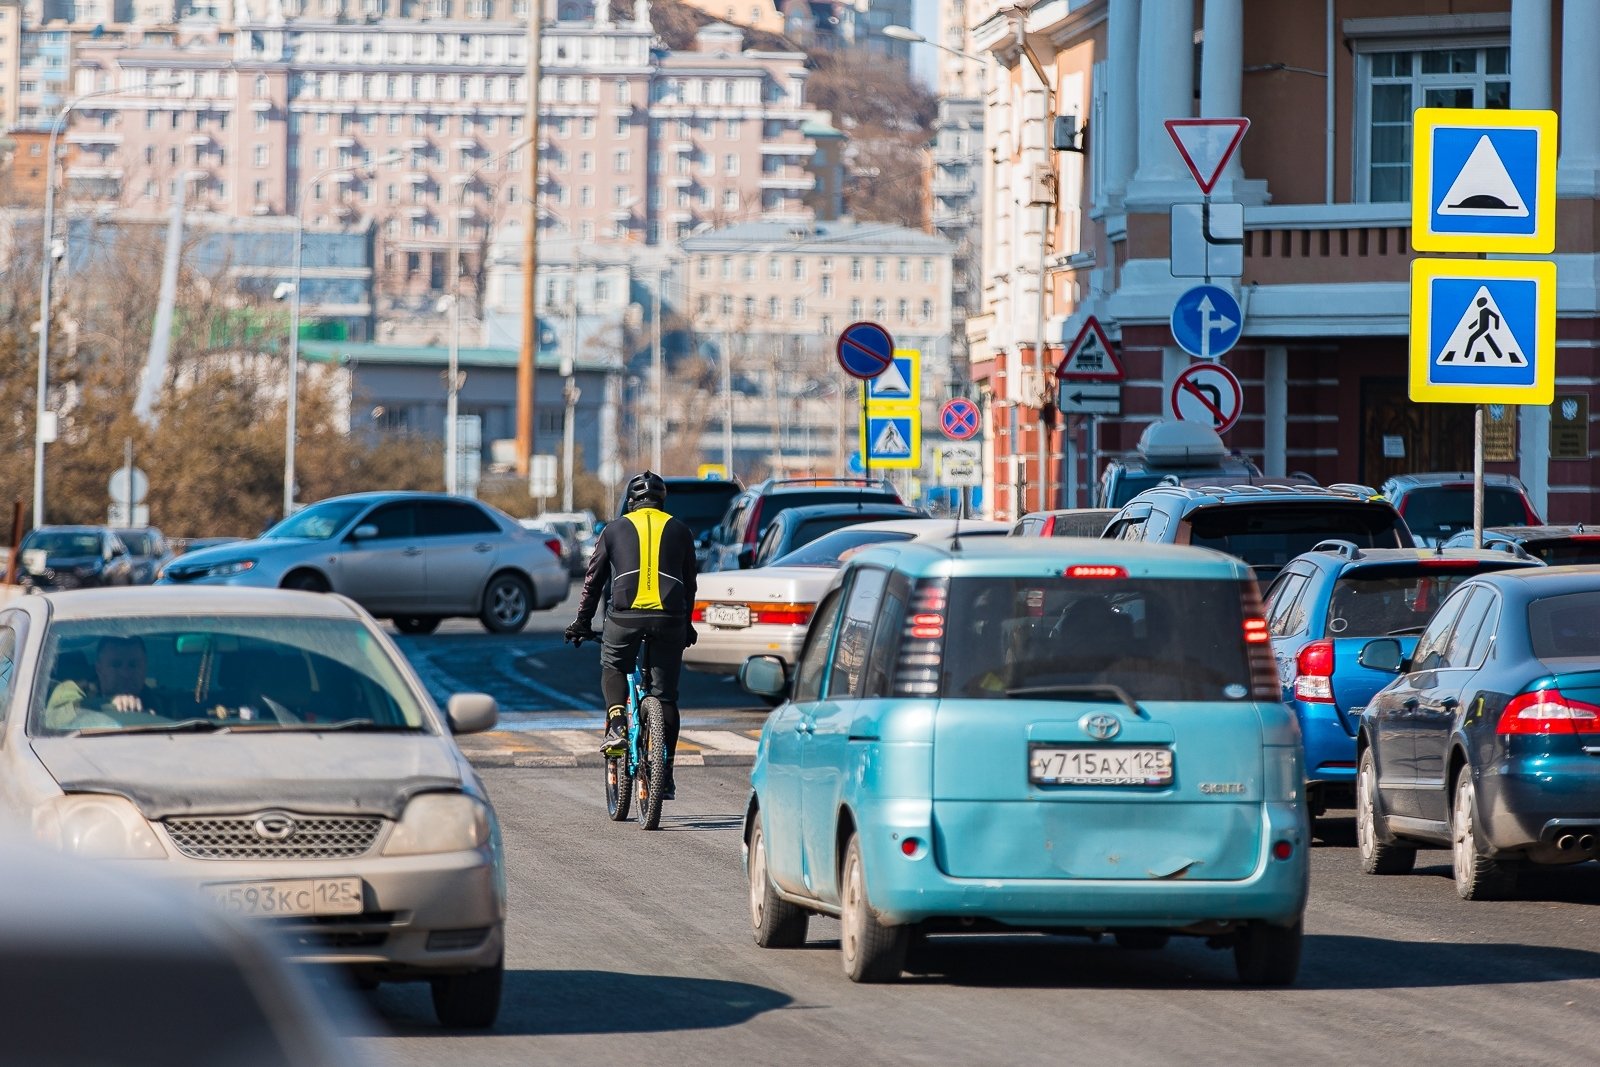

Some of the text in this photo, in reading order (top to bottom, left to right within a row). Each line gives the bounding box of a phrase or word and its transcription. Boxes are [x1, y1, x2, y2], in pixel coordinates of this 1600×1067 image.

[1039, 752, 1165, 775] У715АХ 125
[316, 882, 353, 903] 125
